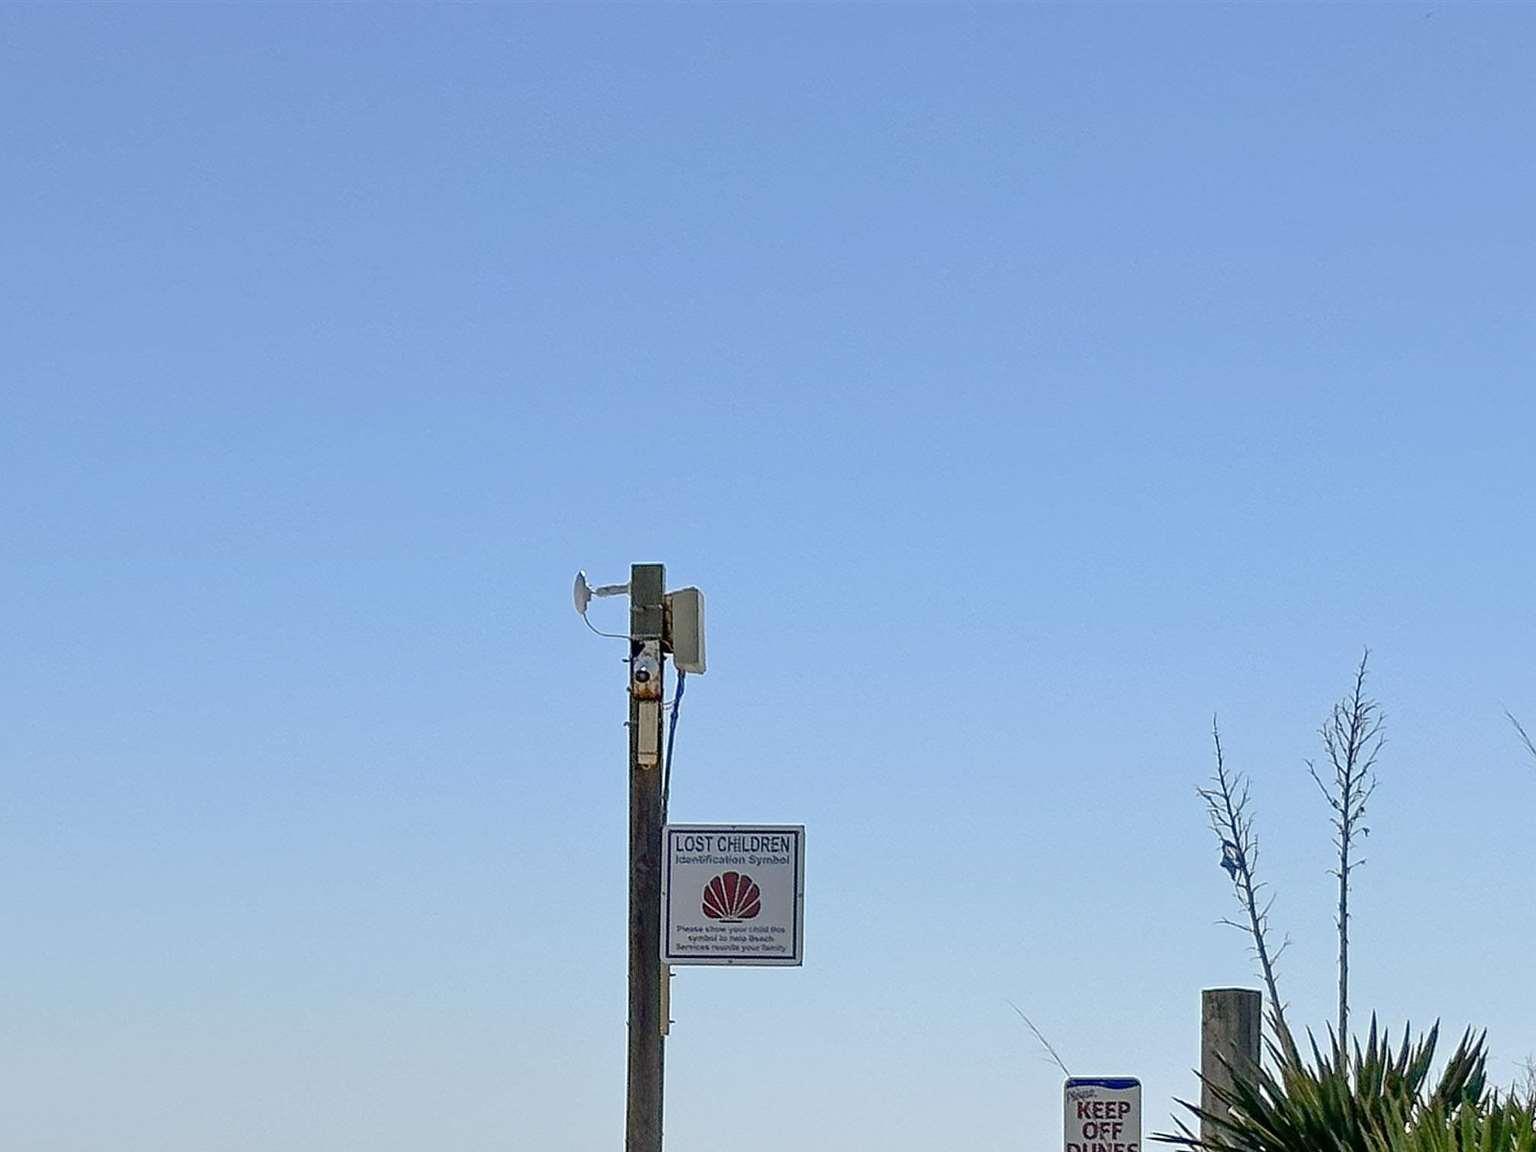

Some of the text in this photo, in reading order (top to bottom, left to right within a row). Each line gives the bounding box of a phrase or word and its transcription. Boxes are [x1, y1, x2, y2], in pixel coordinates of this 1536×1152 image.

[676, 836, 790, 852] LOST CHILDREN
[675, 855, 790, 866] Identification Symbol
[1077, 1101, 1131, 1120] KEEP
[1082, 1121, 1123, 1140] OFF
